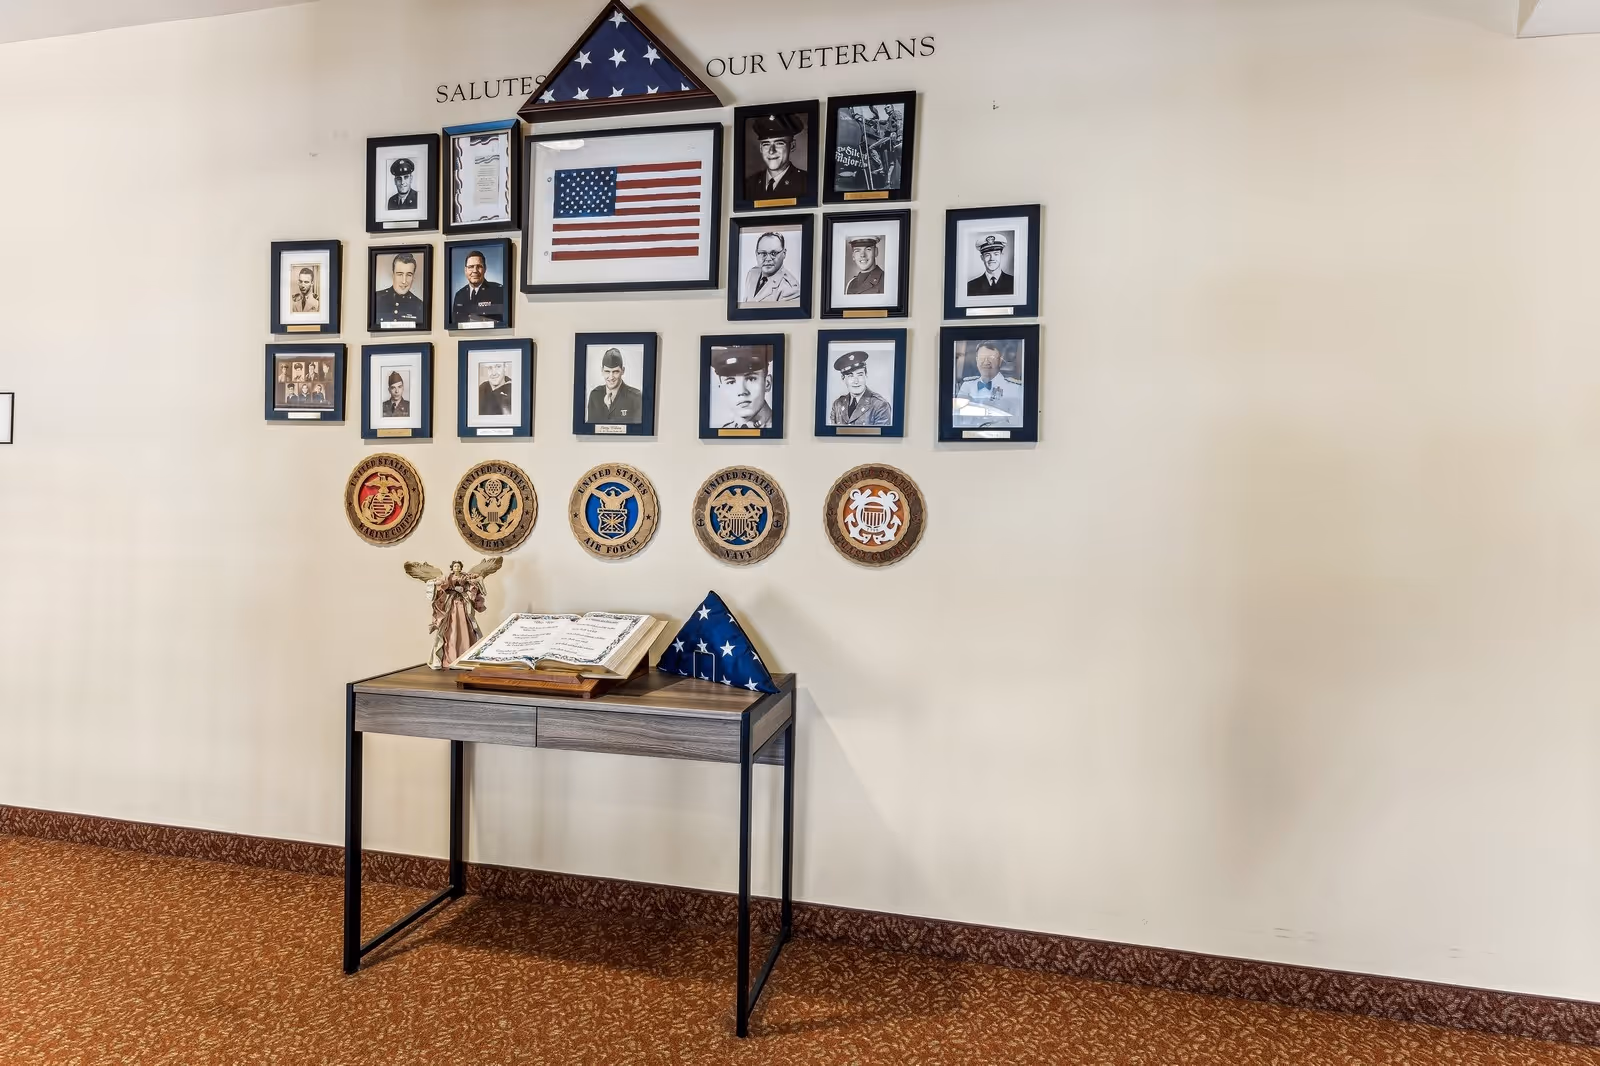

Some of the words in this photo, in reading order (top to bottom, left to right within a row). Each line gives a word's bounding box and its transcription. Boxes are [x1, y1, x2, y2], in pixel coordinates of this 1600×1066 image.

[436, 75, 547, 103] SALUTES
[706, 54, 767, 78] OUR
[778, 36, 935, 71] VETERANS
[351, 460, 376, 487] UNITED
[378, 459, 409, 476] STATES
[462, 466, 492, 490] UNITED
[496, 466, 528, 491] STATES
[578, 469, 611, 494] UNITED
[616, 469, 648, 496] STATES
[704, 471, 738, 495] UNITED
[741, 472, 775, 496] STATES
[358, 522, 390, 539] MARINE
[391, 512, 414, 536] CORPS
[481, 540, 505, 548] ARMY
[584, 538, 602, 552] AIR
[606, 538, 640, 554] FORCE
[725, 550, 752, 559] NAVY
